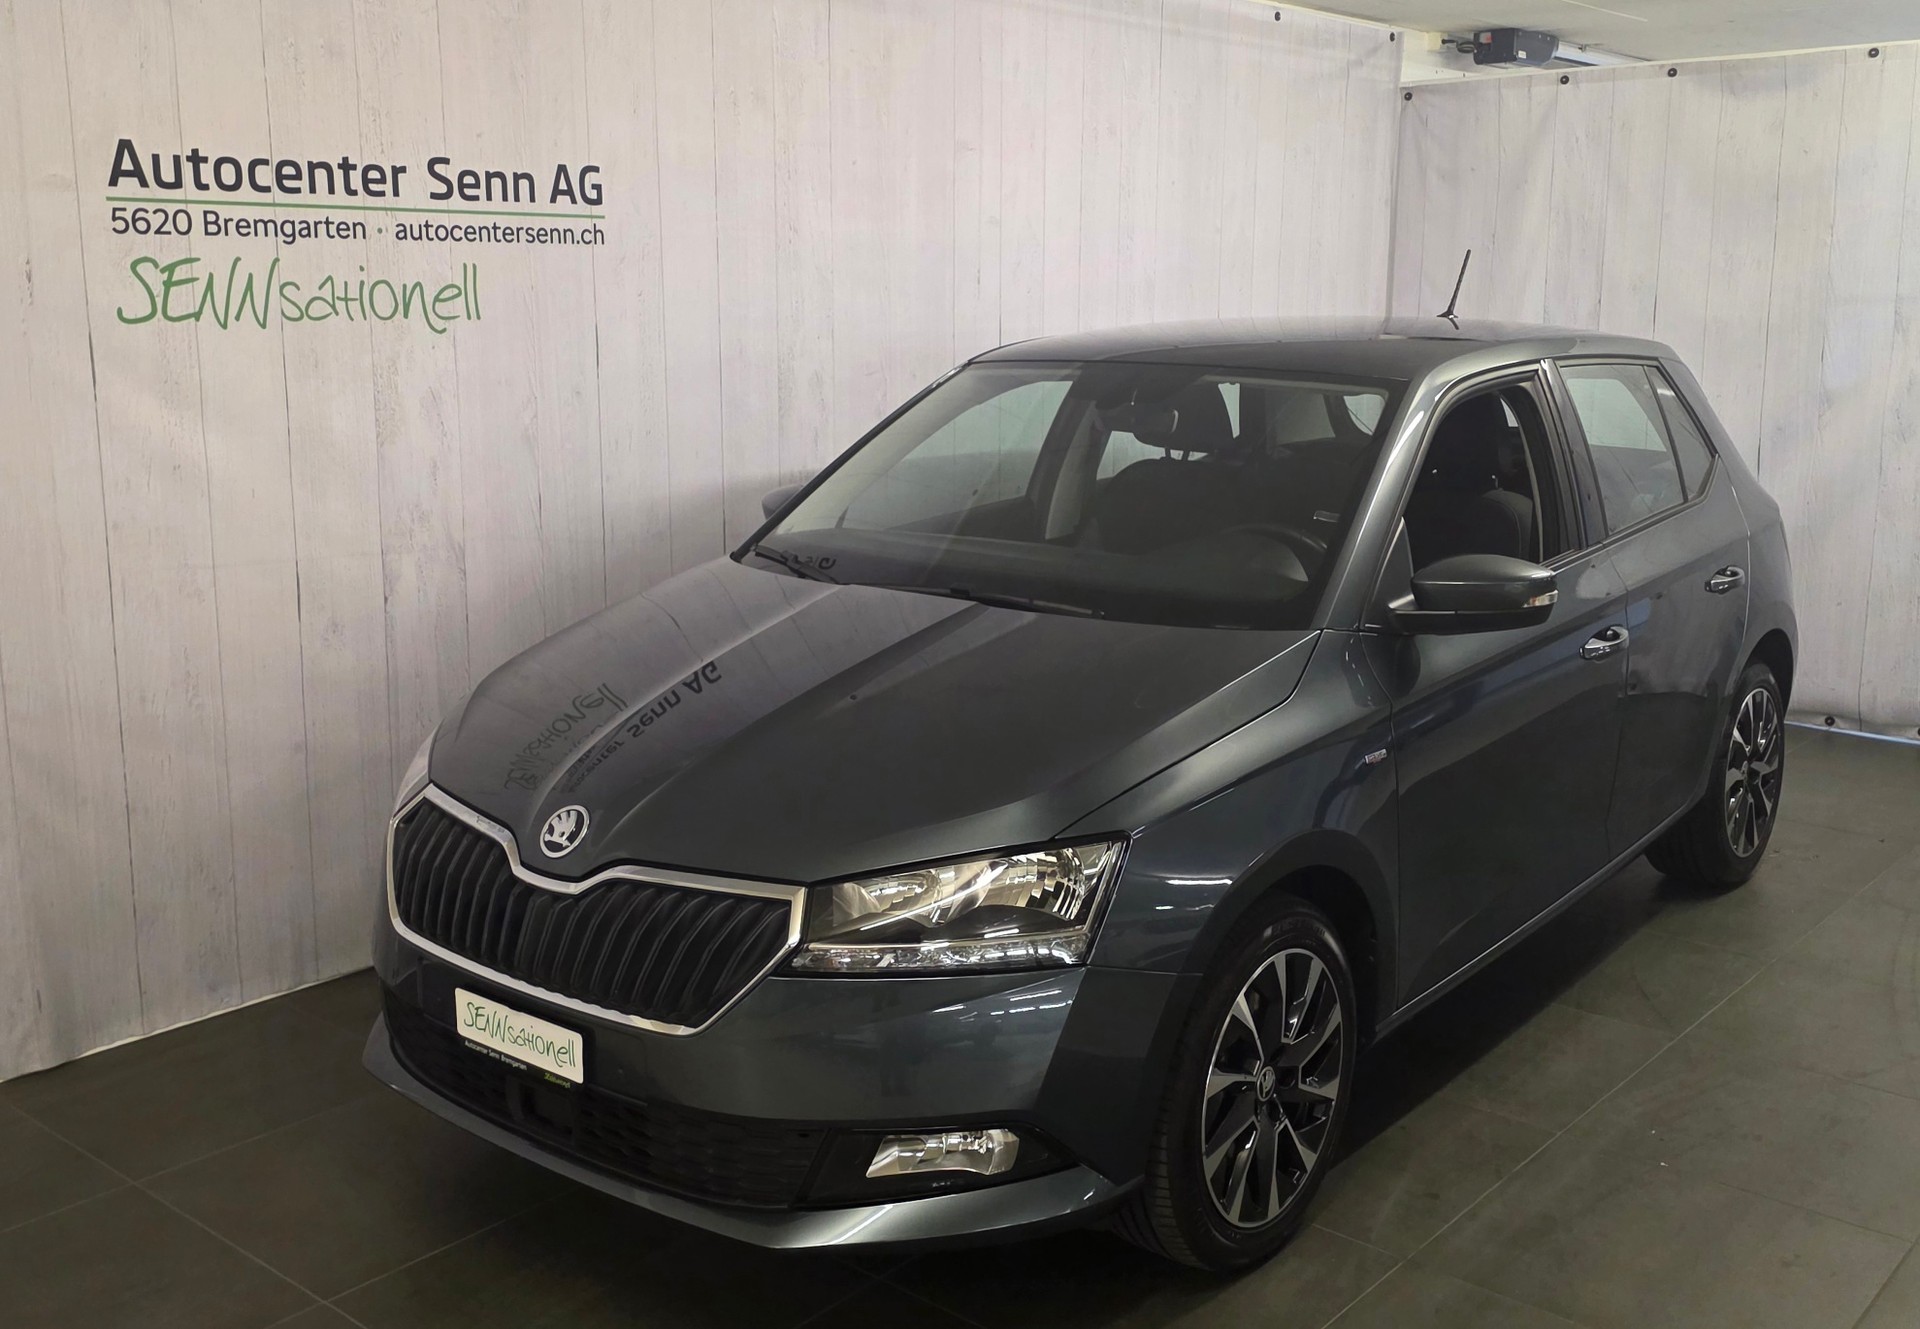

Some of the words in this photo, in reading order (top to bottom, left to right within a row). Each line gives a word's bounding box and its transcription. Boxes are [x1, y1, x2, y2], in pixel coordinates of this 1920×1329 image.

[107, 138, 408, 201] Autocenter
[427, 157, 537, 204] Senn
[549, 163, 605, 207] AG
[111, 206, 194, 237] 5620
[202, 209, 368, 246] Bremgarten
[394, 222, 606, 246] autocentersenn.ch
[116, 255, 482, 335] SENNsationell
[463, 1001, 577, 1068] SENNsationell
